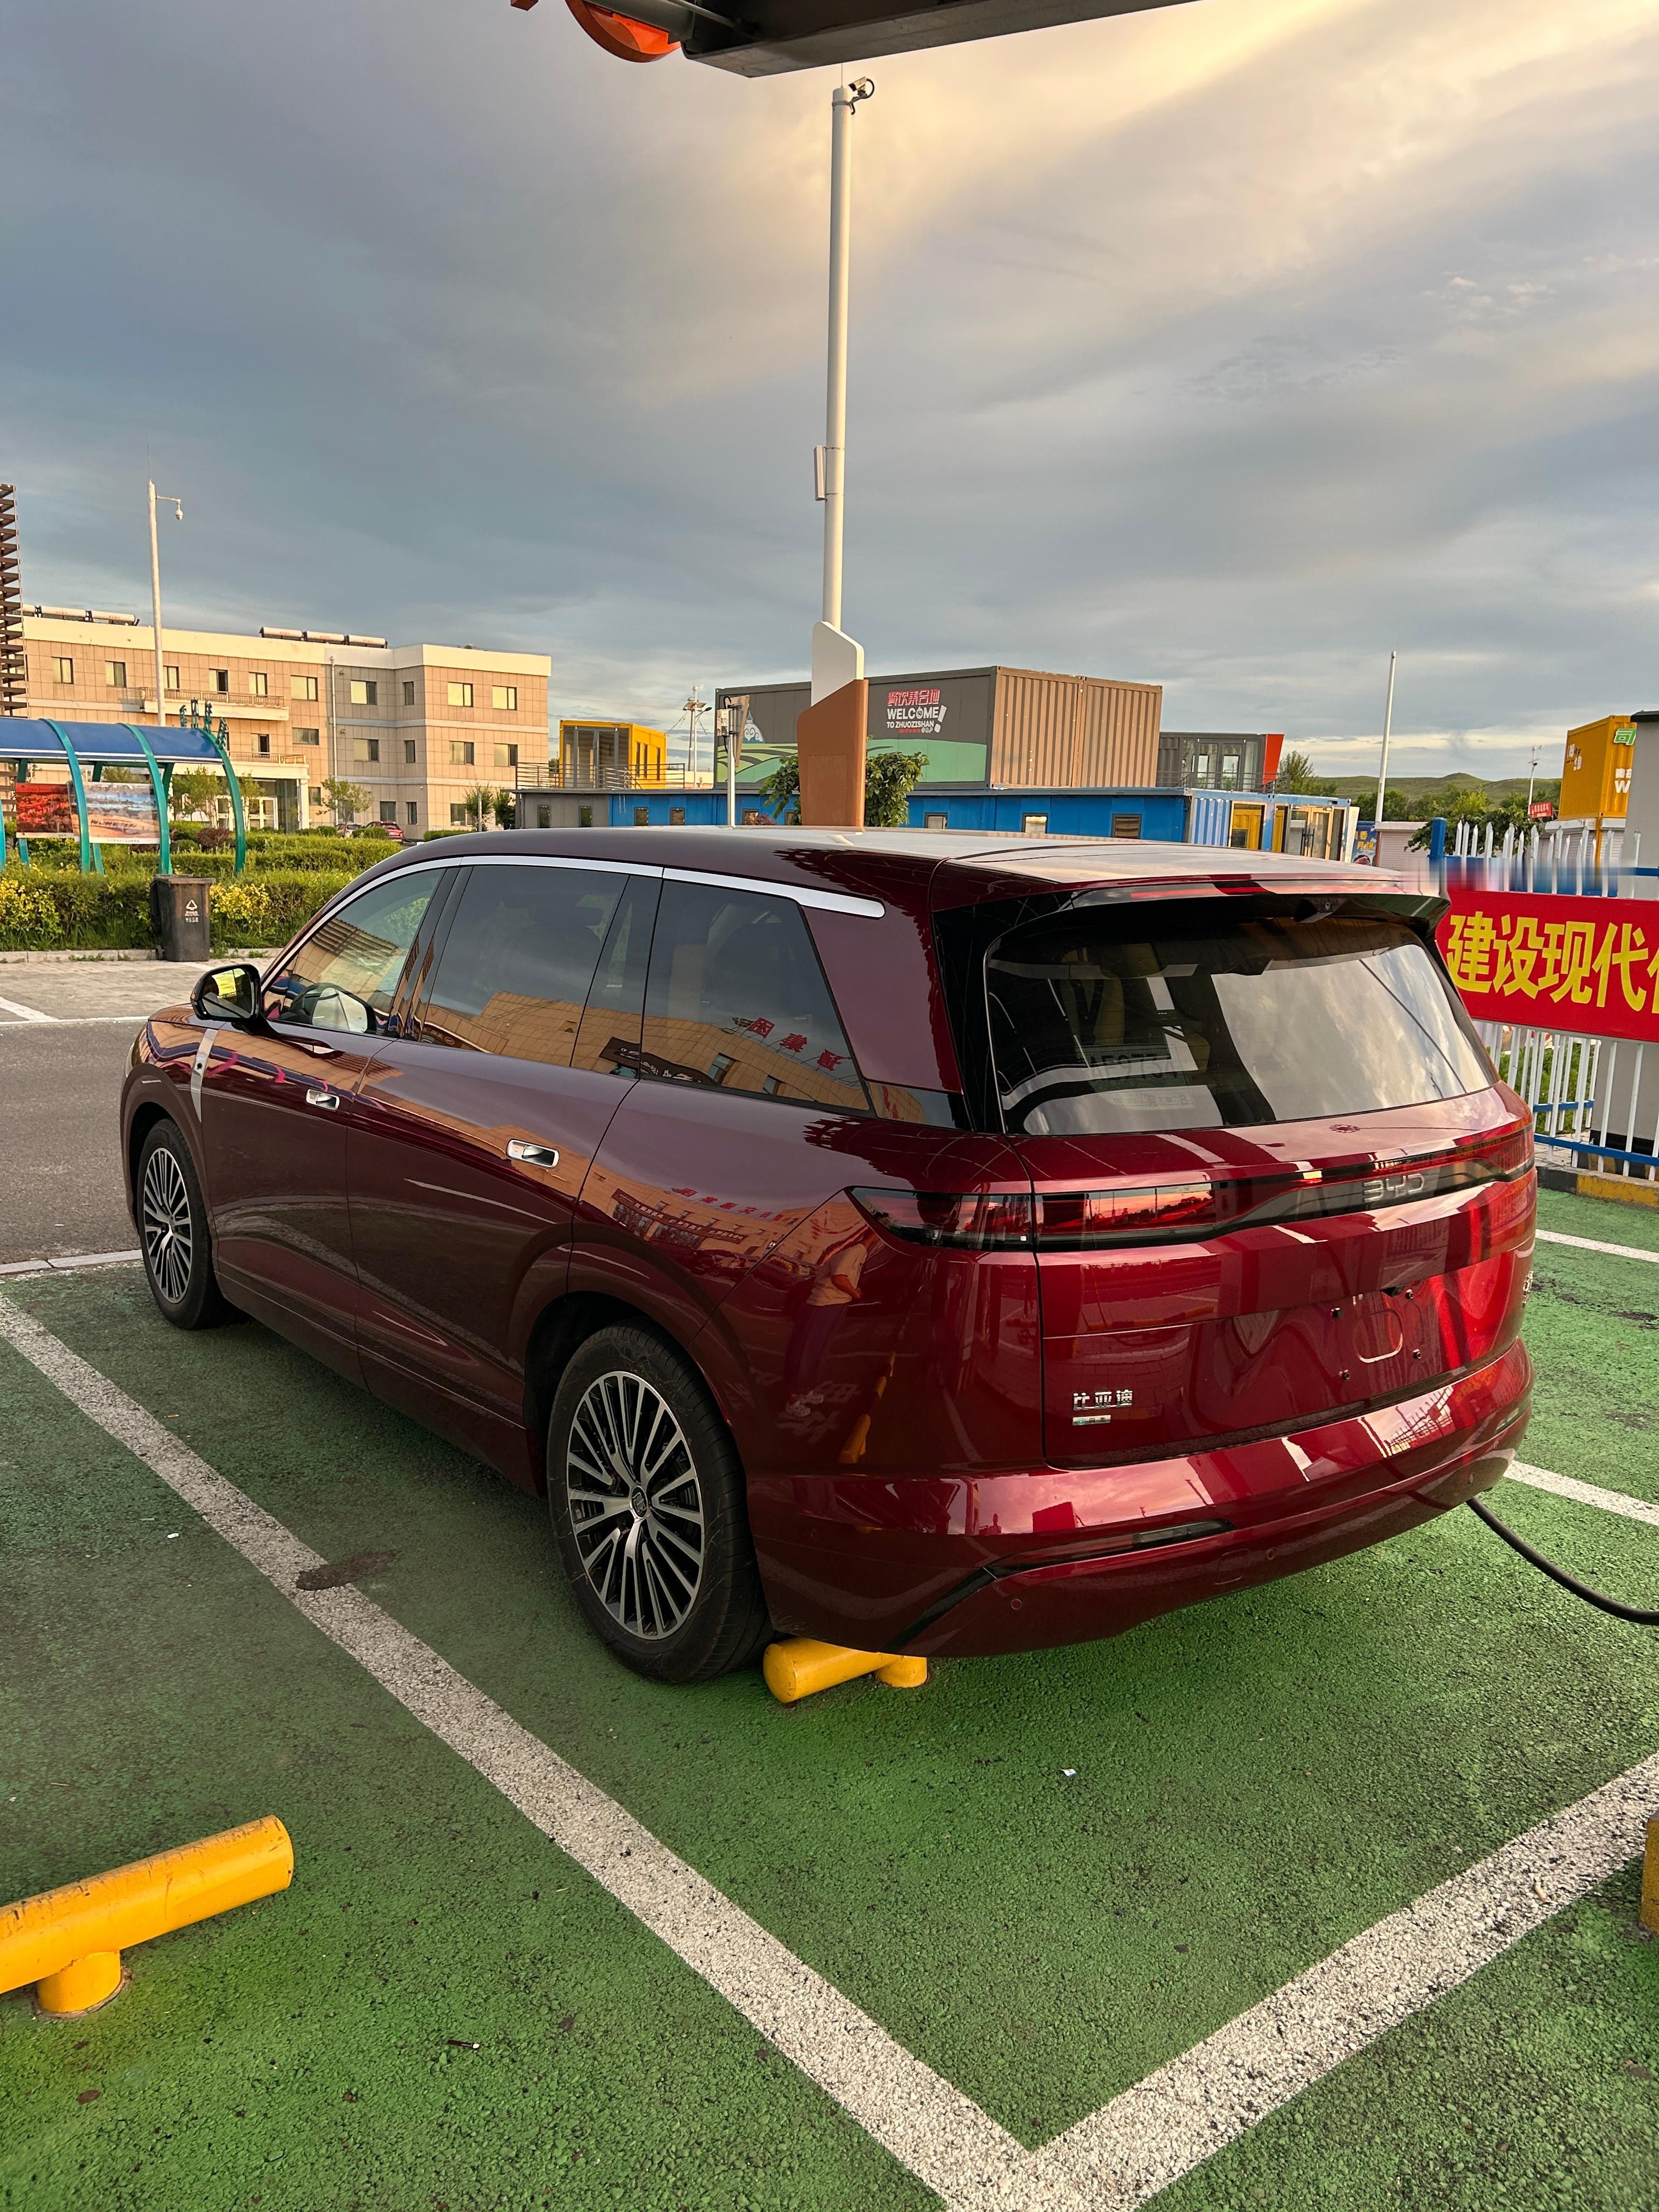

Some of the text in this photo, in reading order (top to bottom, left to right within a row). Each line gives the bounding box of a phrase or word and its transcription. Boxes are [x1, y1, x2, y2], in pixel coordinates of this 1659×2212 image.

[895, 720, 934, 729] ZHUOZISHAN
[1363, 1173, 1425, 1203] BYD
[1073, 1389, 1133, 1411] 比亚迪
